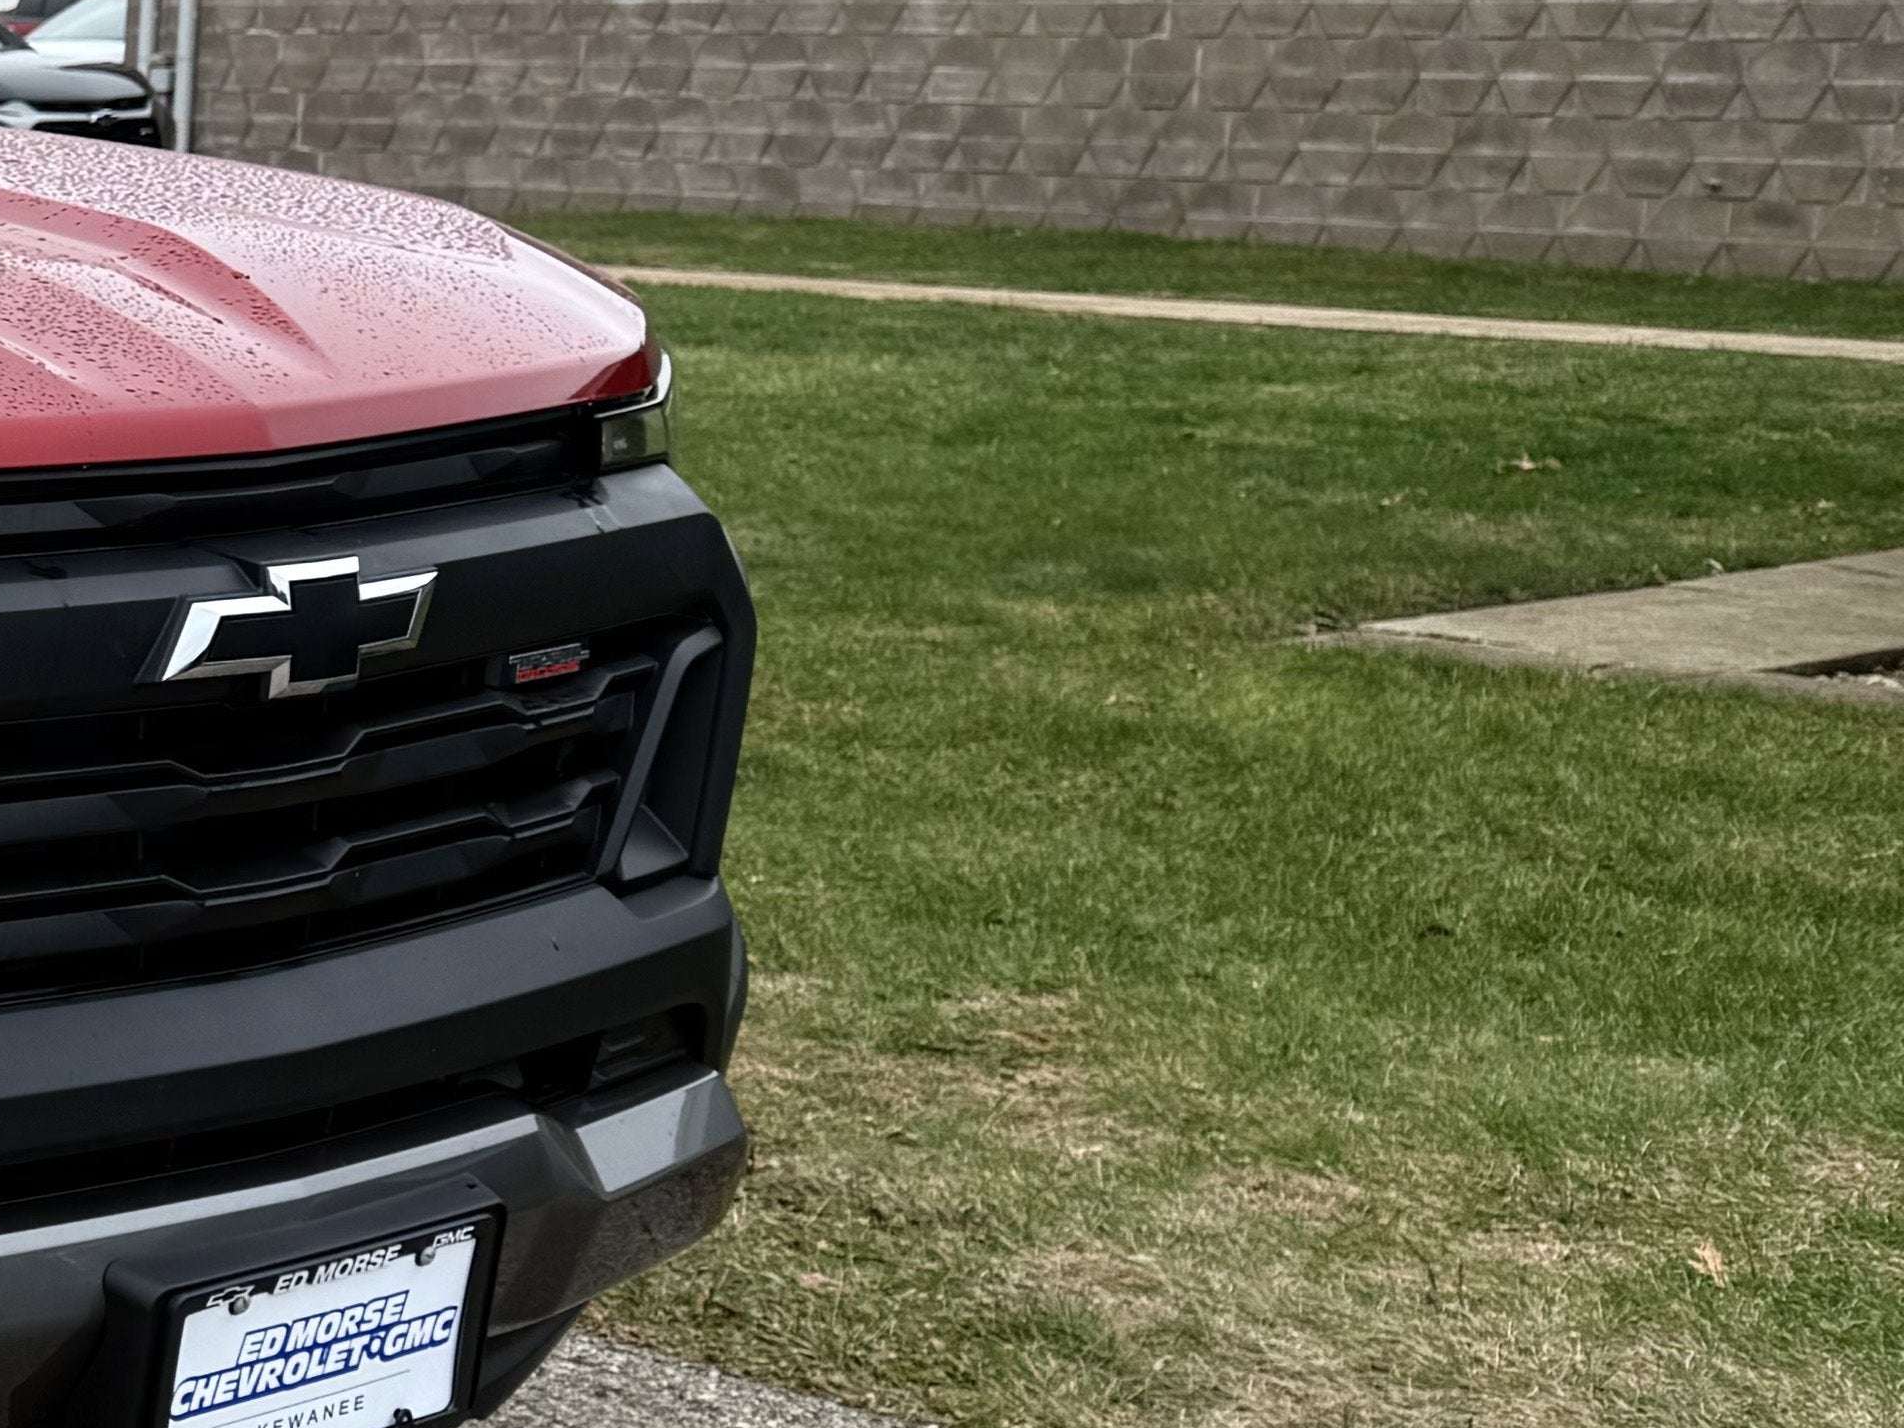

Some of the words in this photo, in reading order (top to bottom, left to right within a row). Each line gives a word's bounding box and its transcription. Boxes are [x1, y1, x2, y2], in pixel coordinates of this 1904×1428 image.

[432, 1225, 476, 1249] GMC
[272, 1270, 309, 1296] ED
[311, 1243, 402, 1286] MORSE
[240, 1323, 289, 1365] ED
[285, 1291, 408, 1353] MORSE
